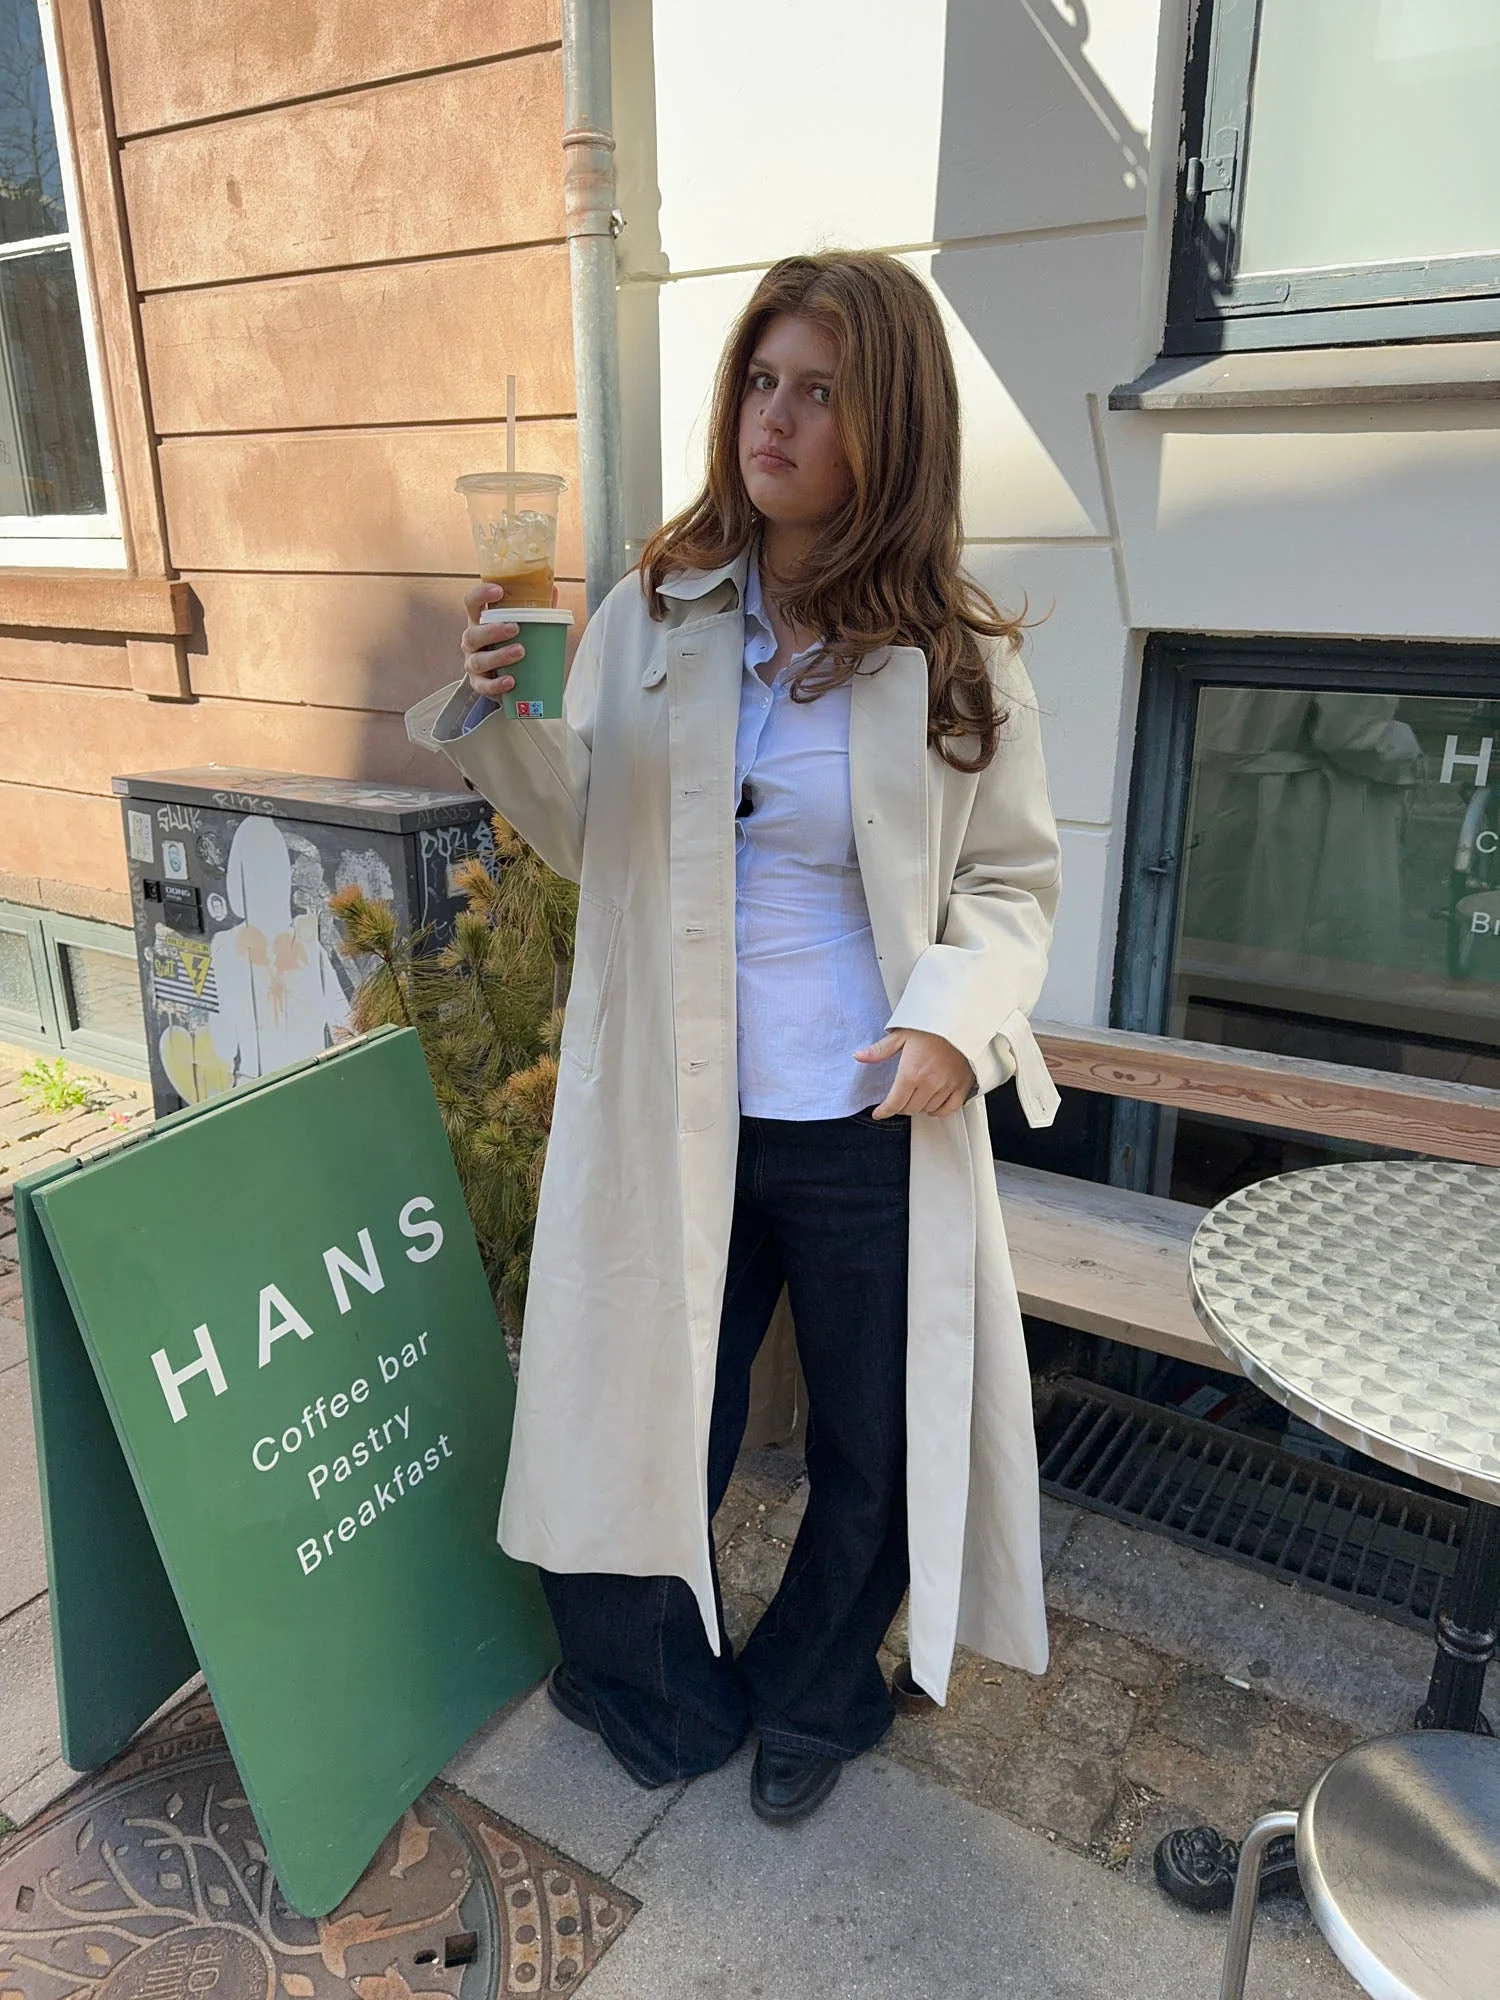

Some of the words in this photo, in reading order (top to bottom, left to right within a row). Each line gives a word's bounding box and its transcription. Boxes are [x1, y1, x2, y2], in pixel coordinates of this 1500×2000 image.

[151, 1196, 444, 1423] HANS
[252, 1378, 369, 1472] Coffee
[378, 1331, 428, 1383] bar
[307, 1406, 411, 1500] Pastry
[296, 1433, 453, 1575] Breakfast
